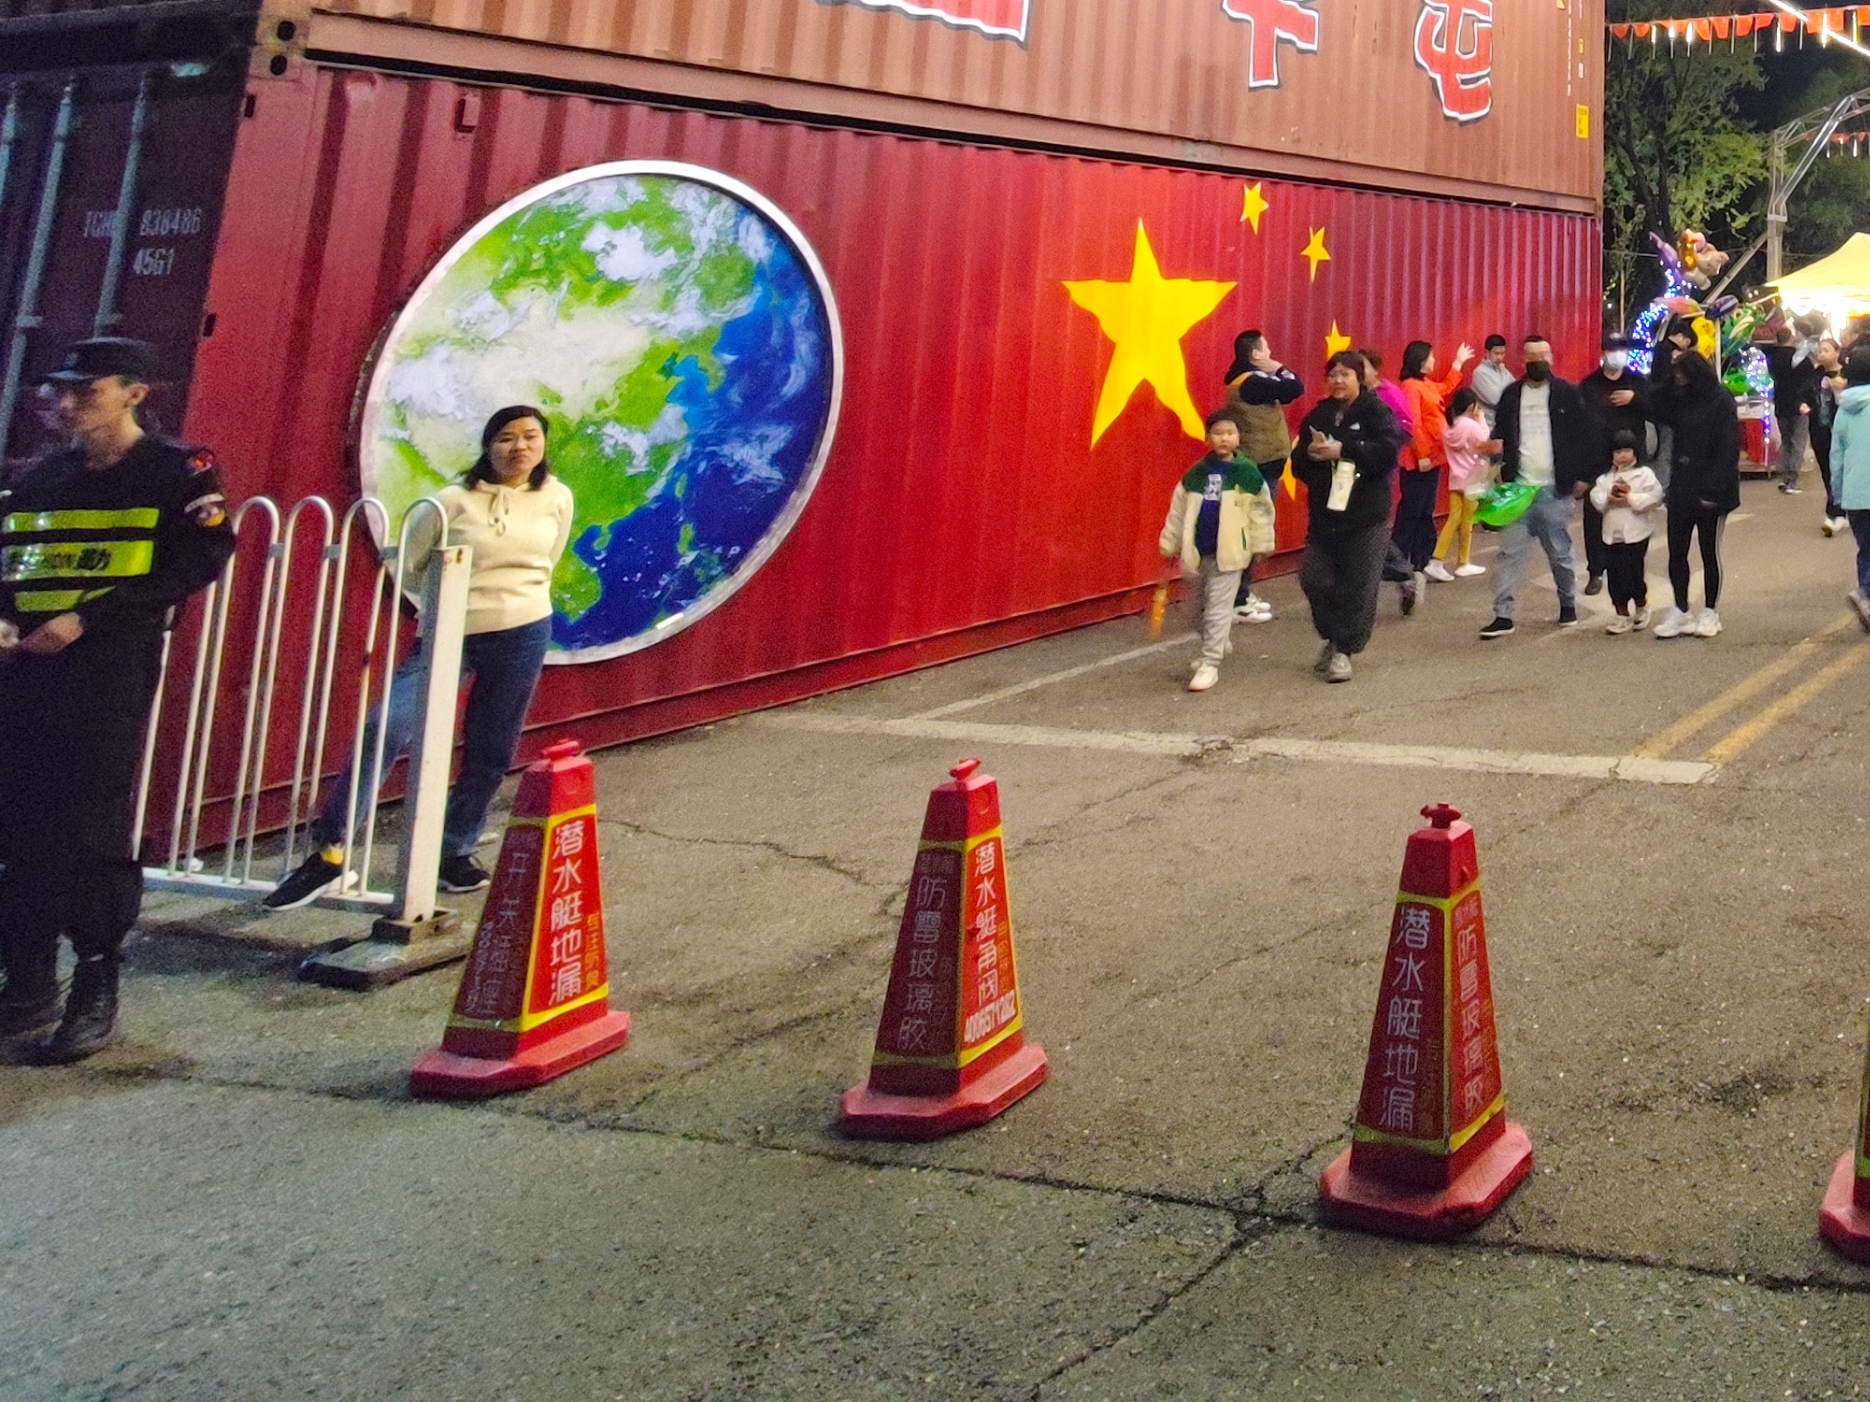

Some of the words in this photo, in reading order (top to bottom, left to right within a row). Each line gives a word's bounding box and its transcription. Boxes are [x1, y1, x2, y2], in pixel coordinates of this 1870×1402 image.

[547, 819, 586, 1006] 潜水艇地漏
[974, 841, 999, 1009] 潜水艇角阀
[1378, 906, 1432, 1132] 潜水艇地漏
